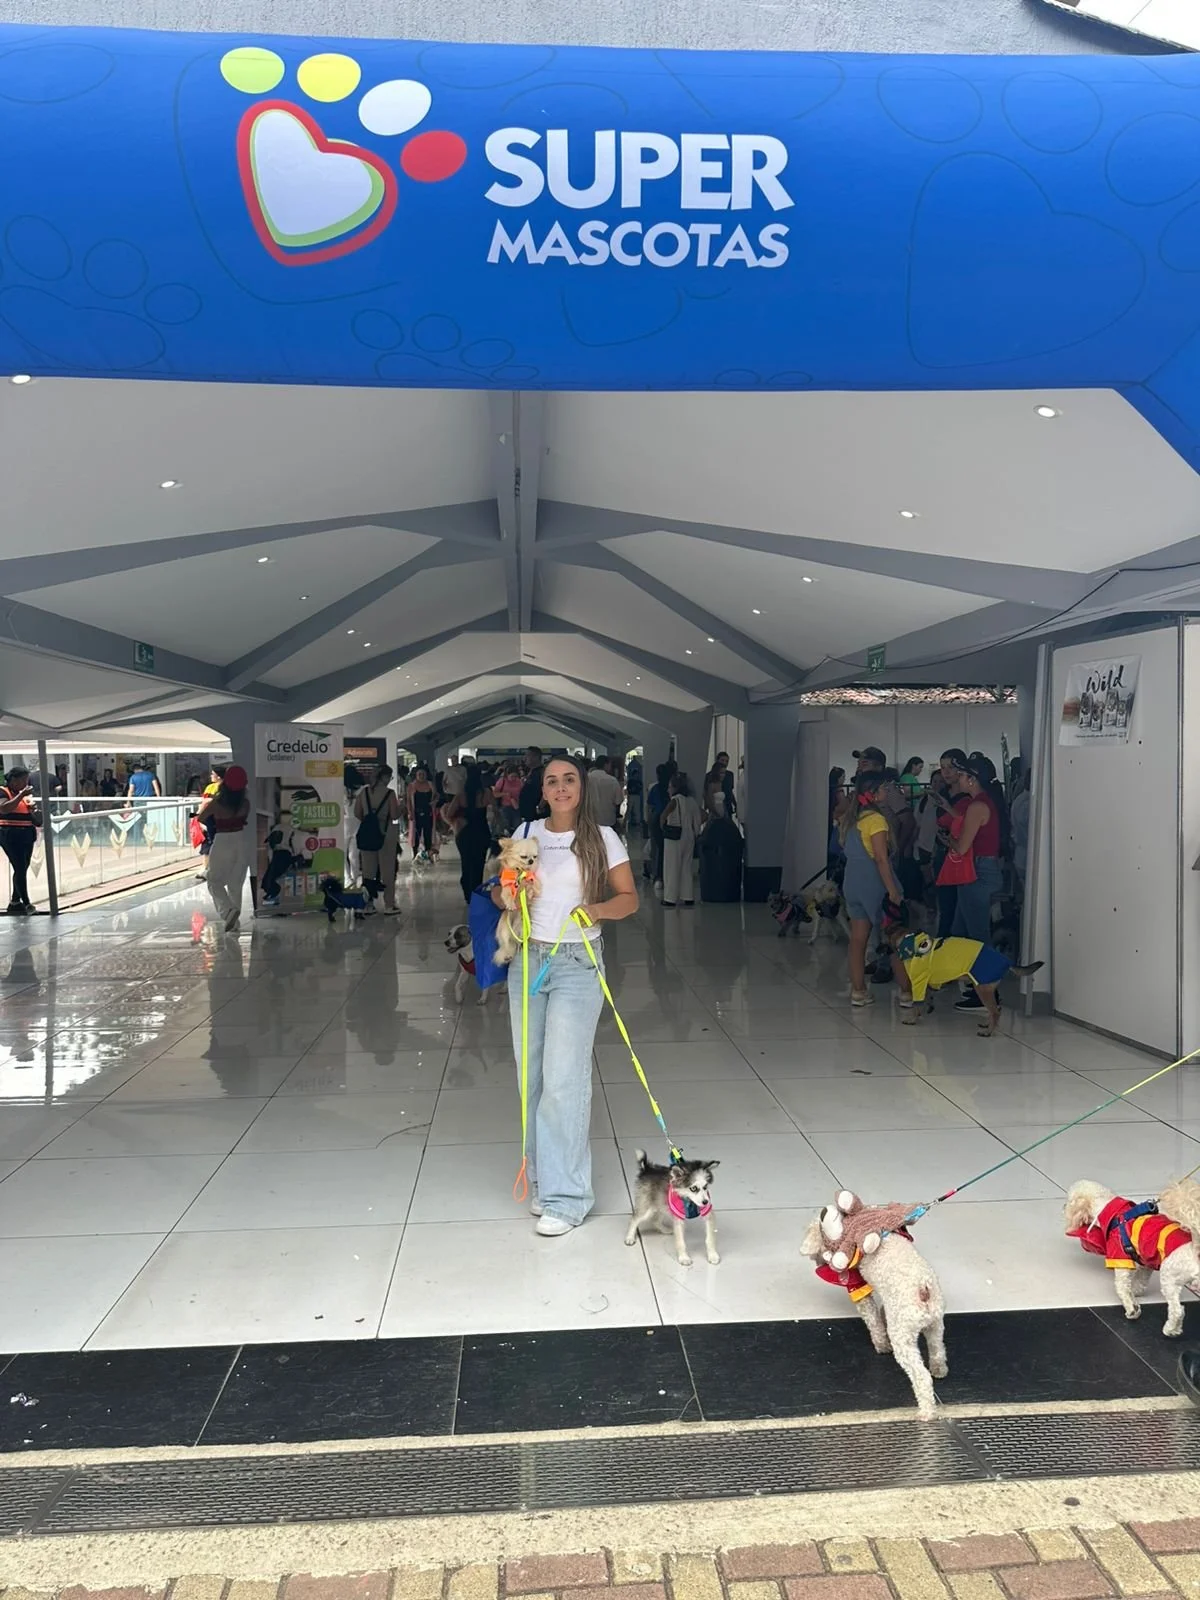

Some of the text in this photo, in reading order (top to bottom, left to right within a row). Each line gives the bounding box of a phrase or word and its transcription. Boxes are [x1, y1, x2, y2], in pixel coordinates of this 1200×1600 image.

[484, 127, 795, 211] SUPER
[487, 219, 790, 268] MASCOTAS
[1086, 665, 1126, 694] Wild
[267, 740, 328, 753] Credelio
[303, 805, 336, 818] PASTILLA
